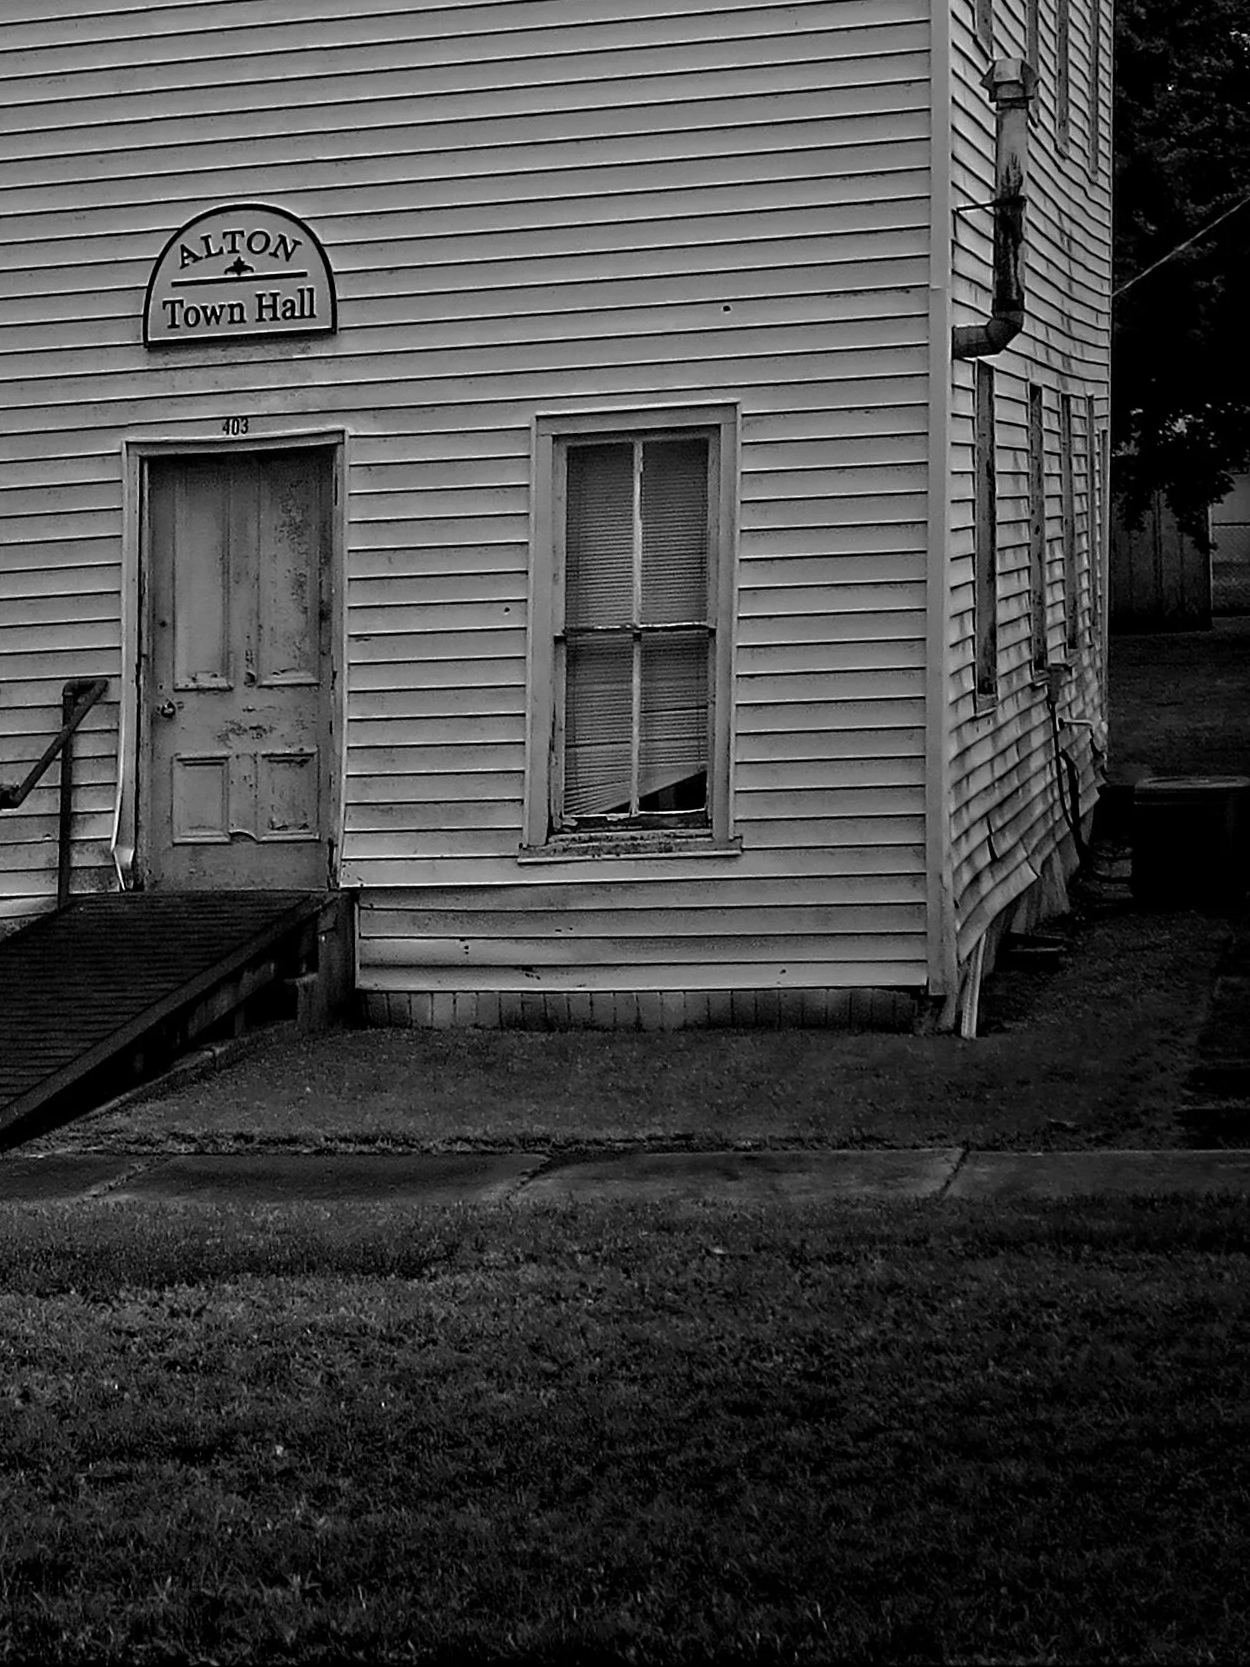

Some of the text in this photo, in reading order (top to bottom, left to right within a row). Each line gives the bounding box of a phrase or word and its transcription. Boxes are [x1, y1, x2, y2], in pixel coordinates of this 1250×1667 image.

[179, 229, 303, 270] ALTON
[162, 286, 317, 329] Town Hall
[222, 417, 249, 435] 403
